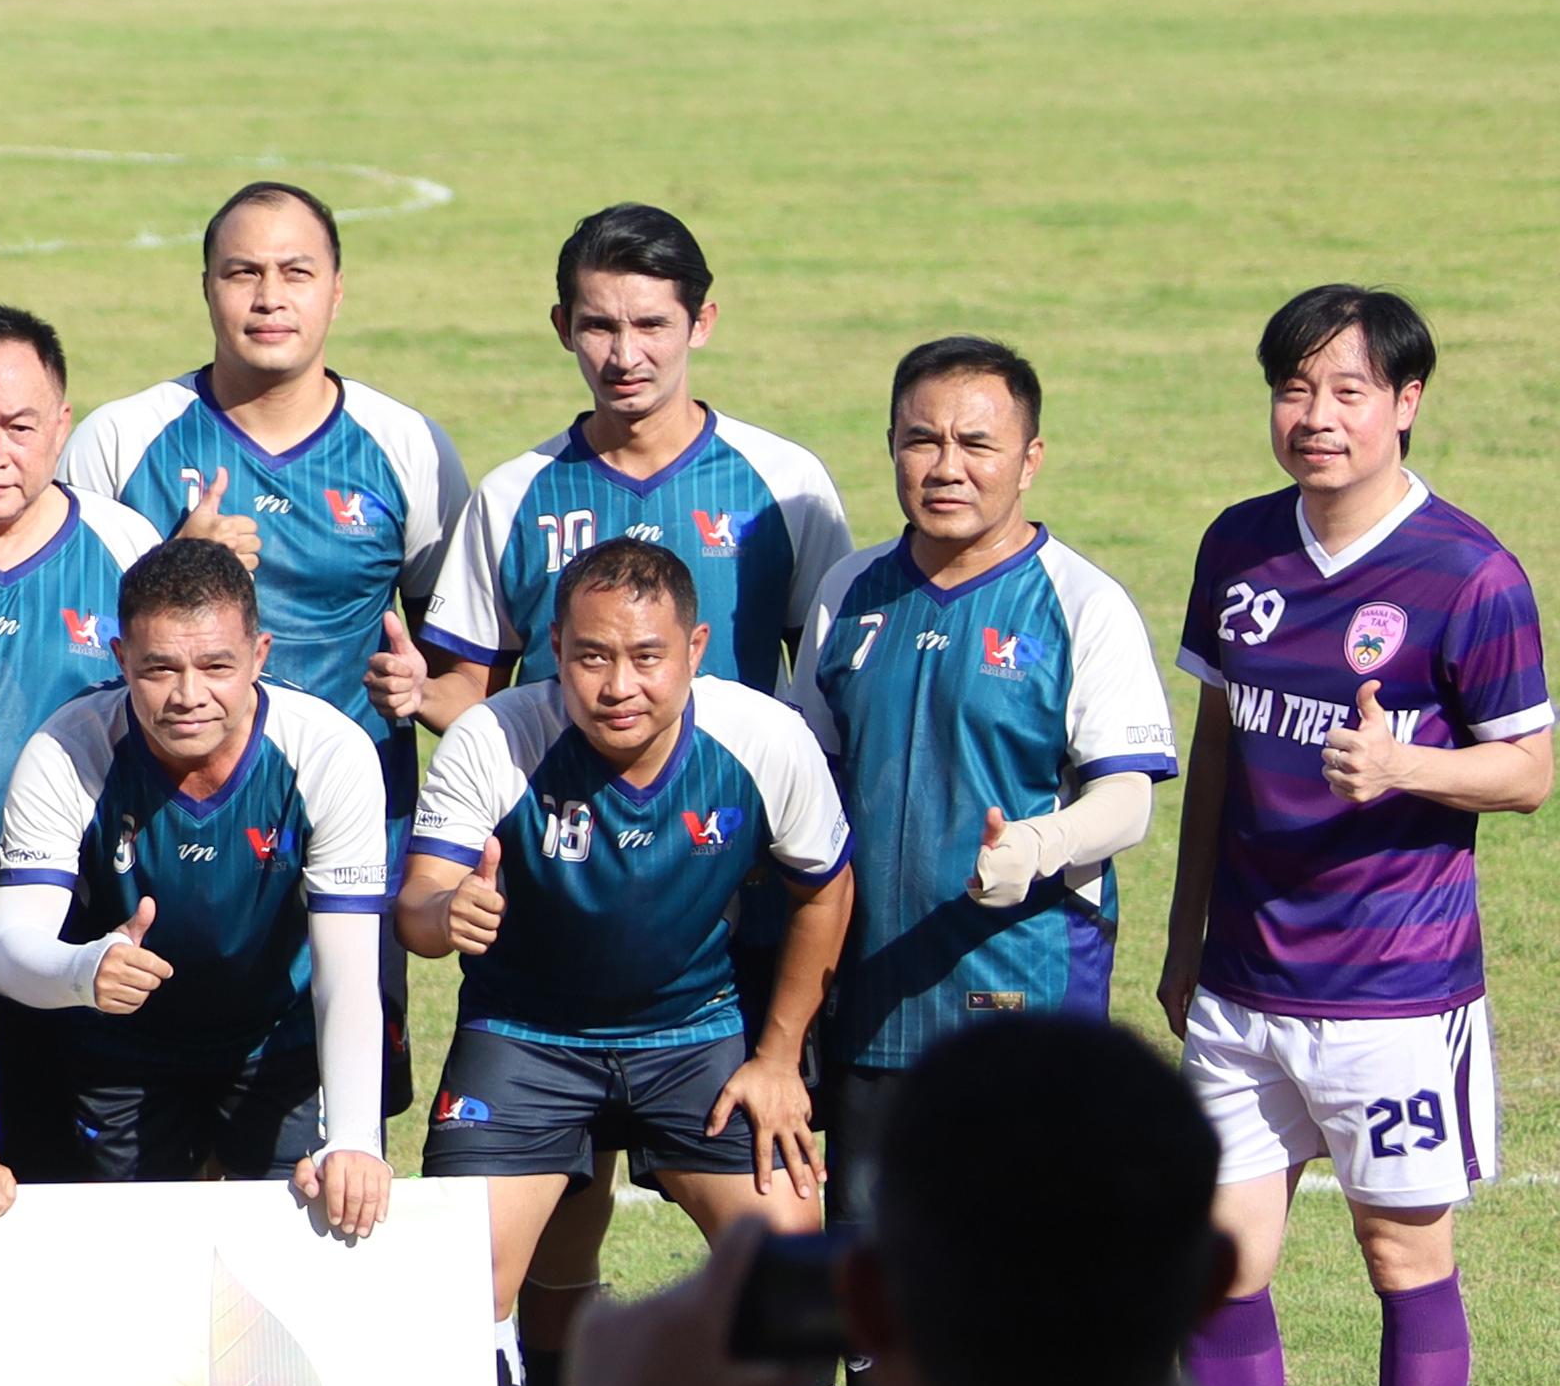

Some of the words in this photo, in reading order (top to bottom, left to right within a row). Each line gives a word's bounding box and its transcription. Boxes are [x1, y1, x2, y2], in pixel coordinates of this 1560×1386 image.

[1217, 582, 1286, 646] 29
[334, 866, 360, 885] VIP
[1365, 1088, 1448, 1159] 29
